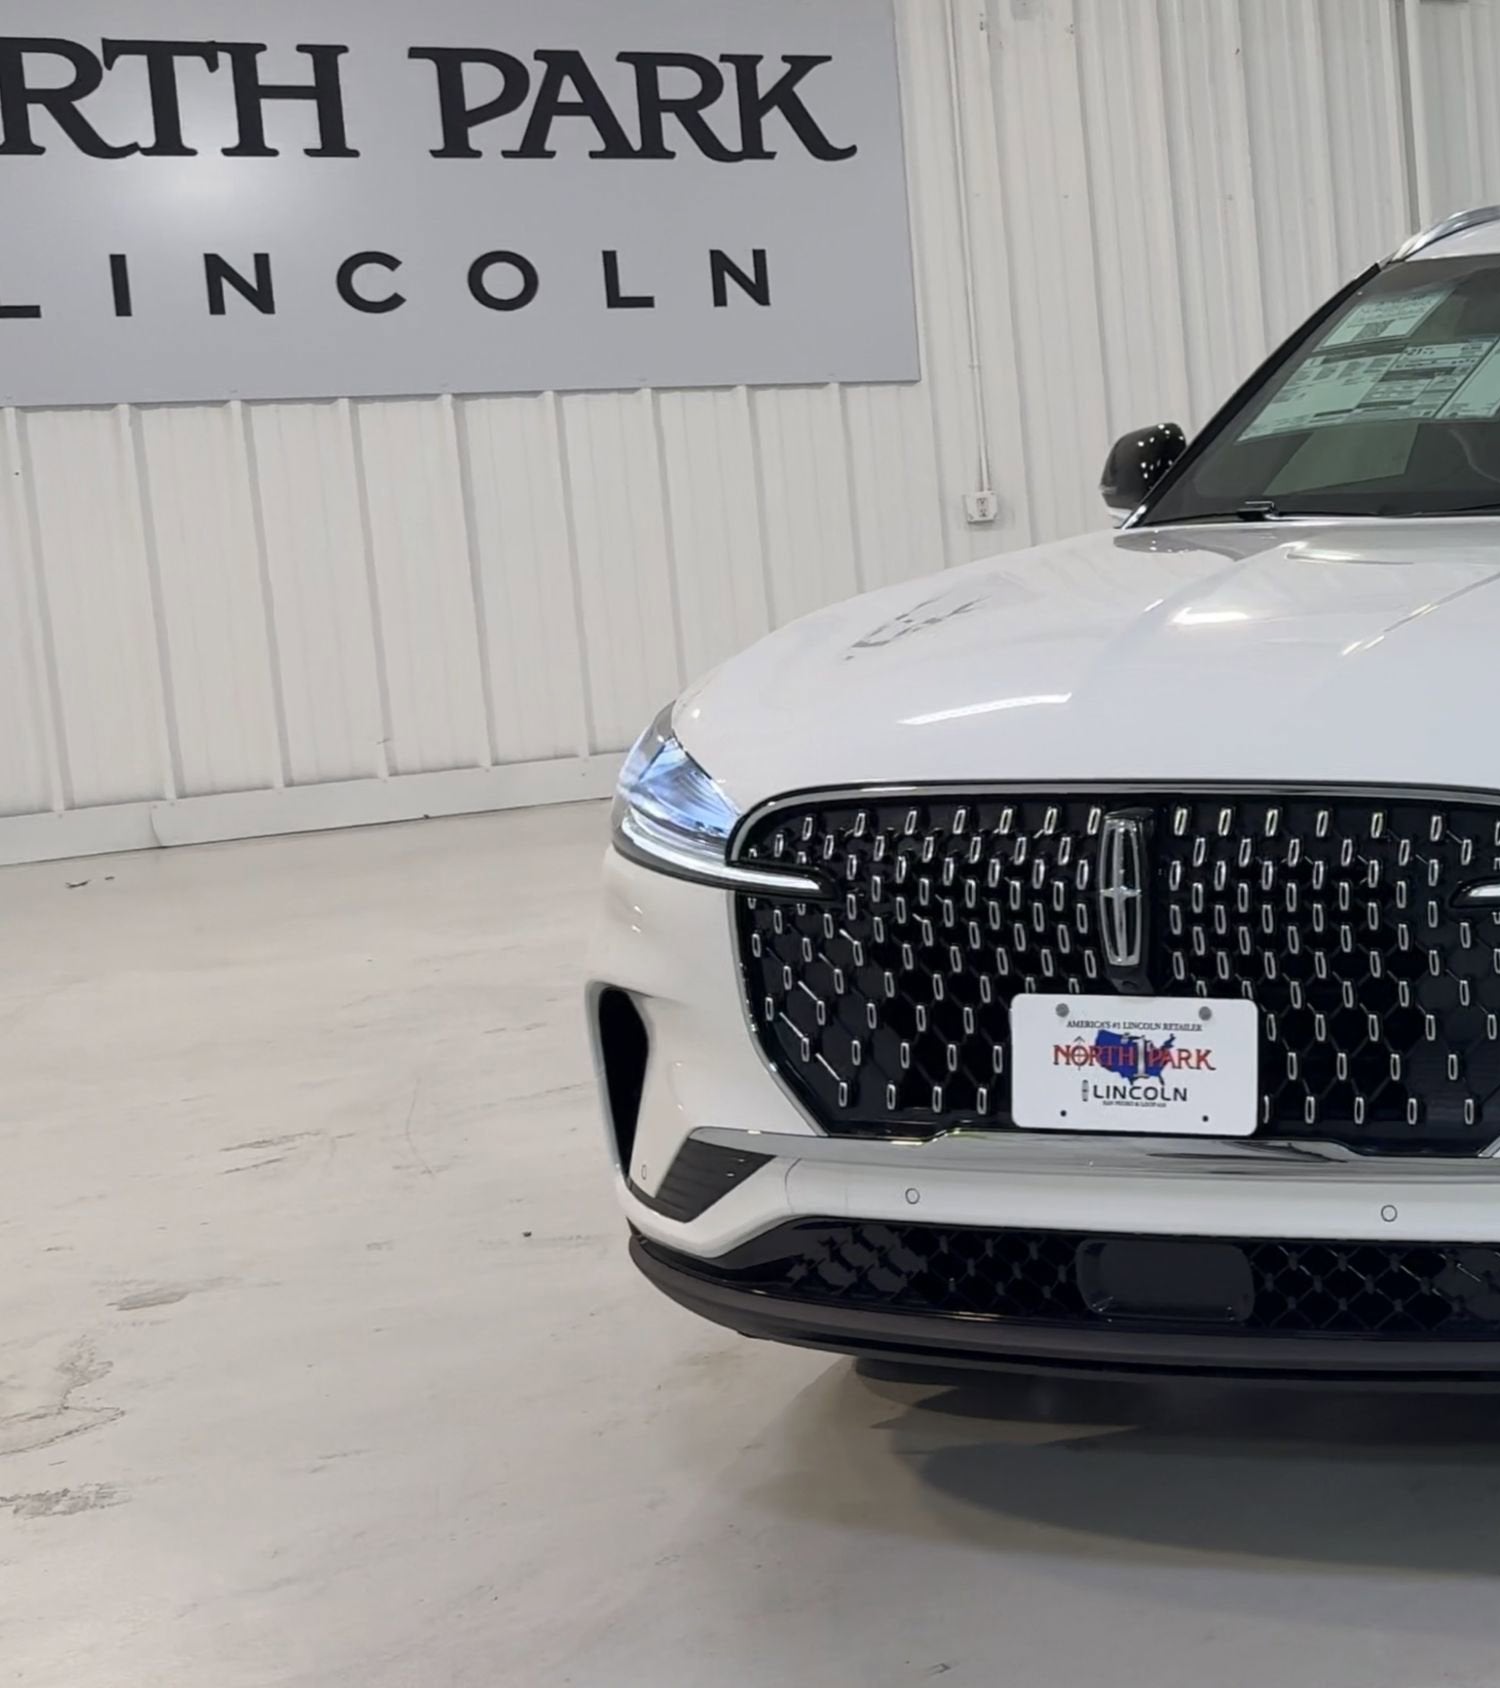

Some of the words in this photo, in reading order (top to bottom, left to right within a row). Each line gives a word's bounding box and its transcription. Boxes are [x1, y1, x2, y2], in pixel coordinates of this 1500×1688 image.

[407, 46, 859, 163] PARK
[1066, 1019, 1111, 1030] AMERICA'S
[1112, 1021, 1121, 1030] #1
[1122, 1021, 1162, 1031] LINCOLN
[1163, 1022, 1204, 1032] RETAILER
[1052, 1044, 1135, 1067] NORTH
[1148, 1047, 1217, 1071] PARK
[1093, 1085, 1188, 1102] LINCOLN
